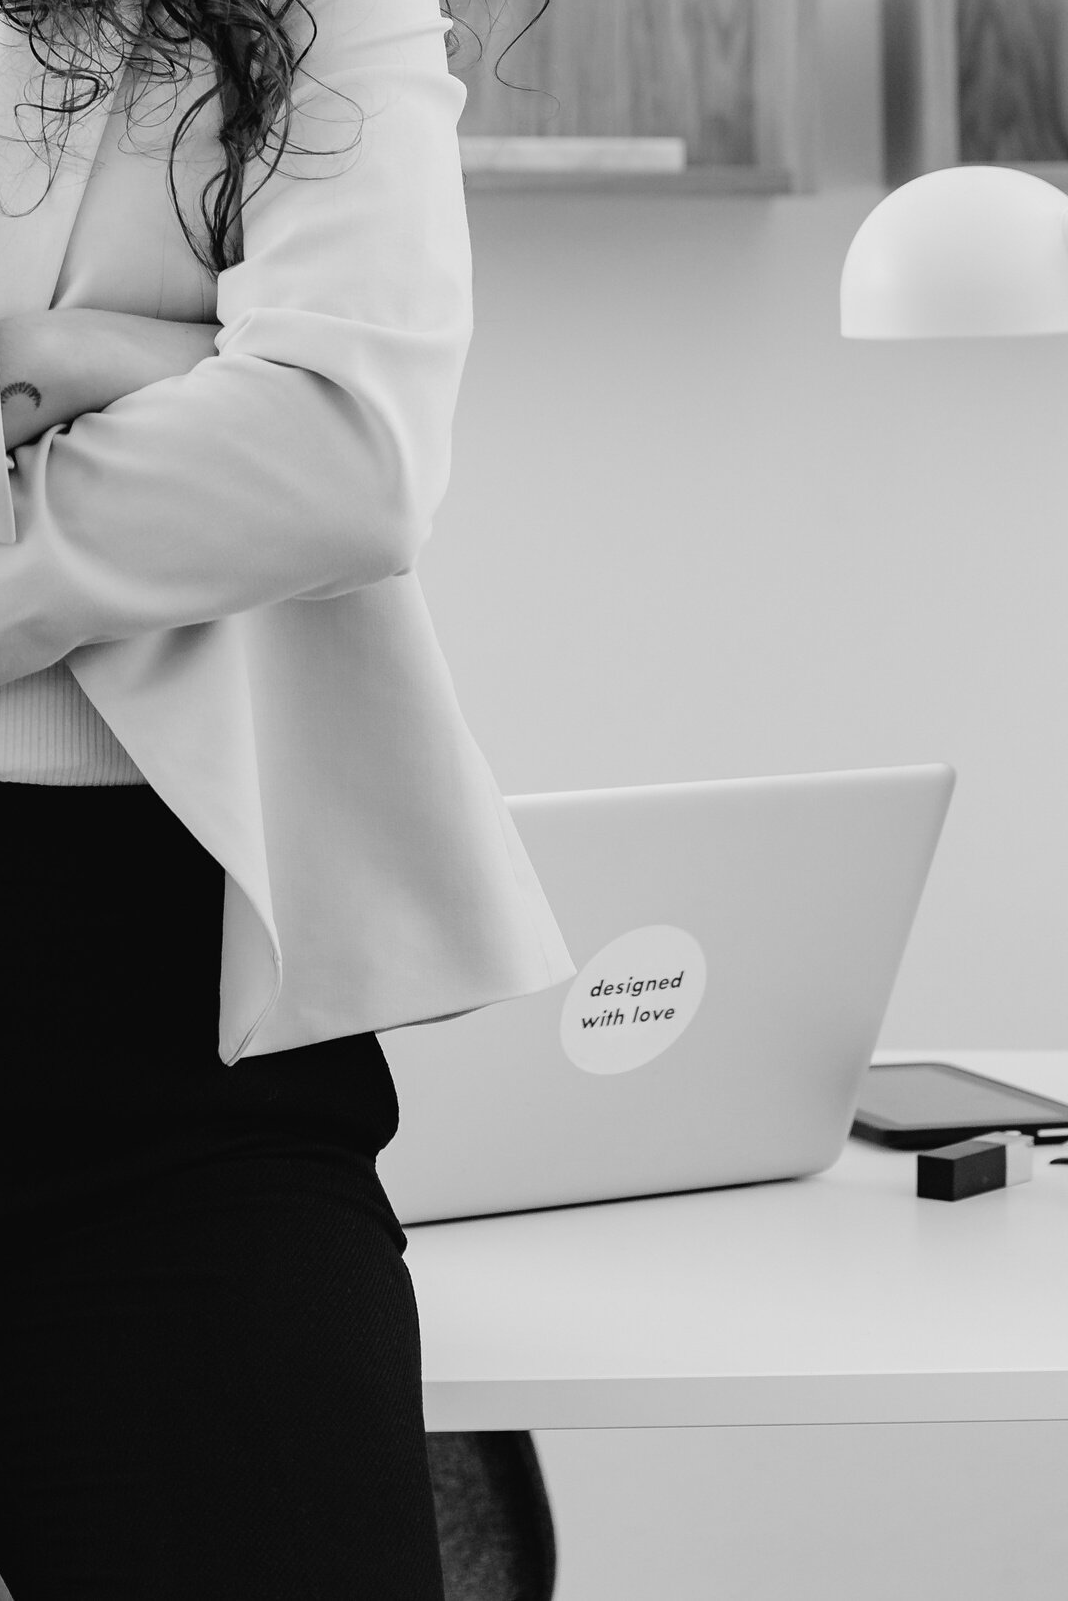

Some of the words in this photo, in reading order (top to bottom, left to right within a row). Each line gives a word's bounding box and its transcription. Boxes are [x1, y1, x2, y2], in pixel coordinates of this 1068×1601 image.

[590, 970, 684, 997] designed
[582, 1008, 624, 1029] with
[632, 1006, 675, 1023] love
